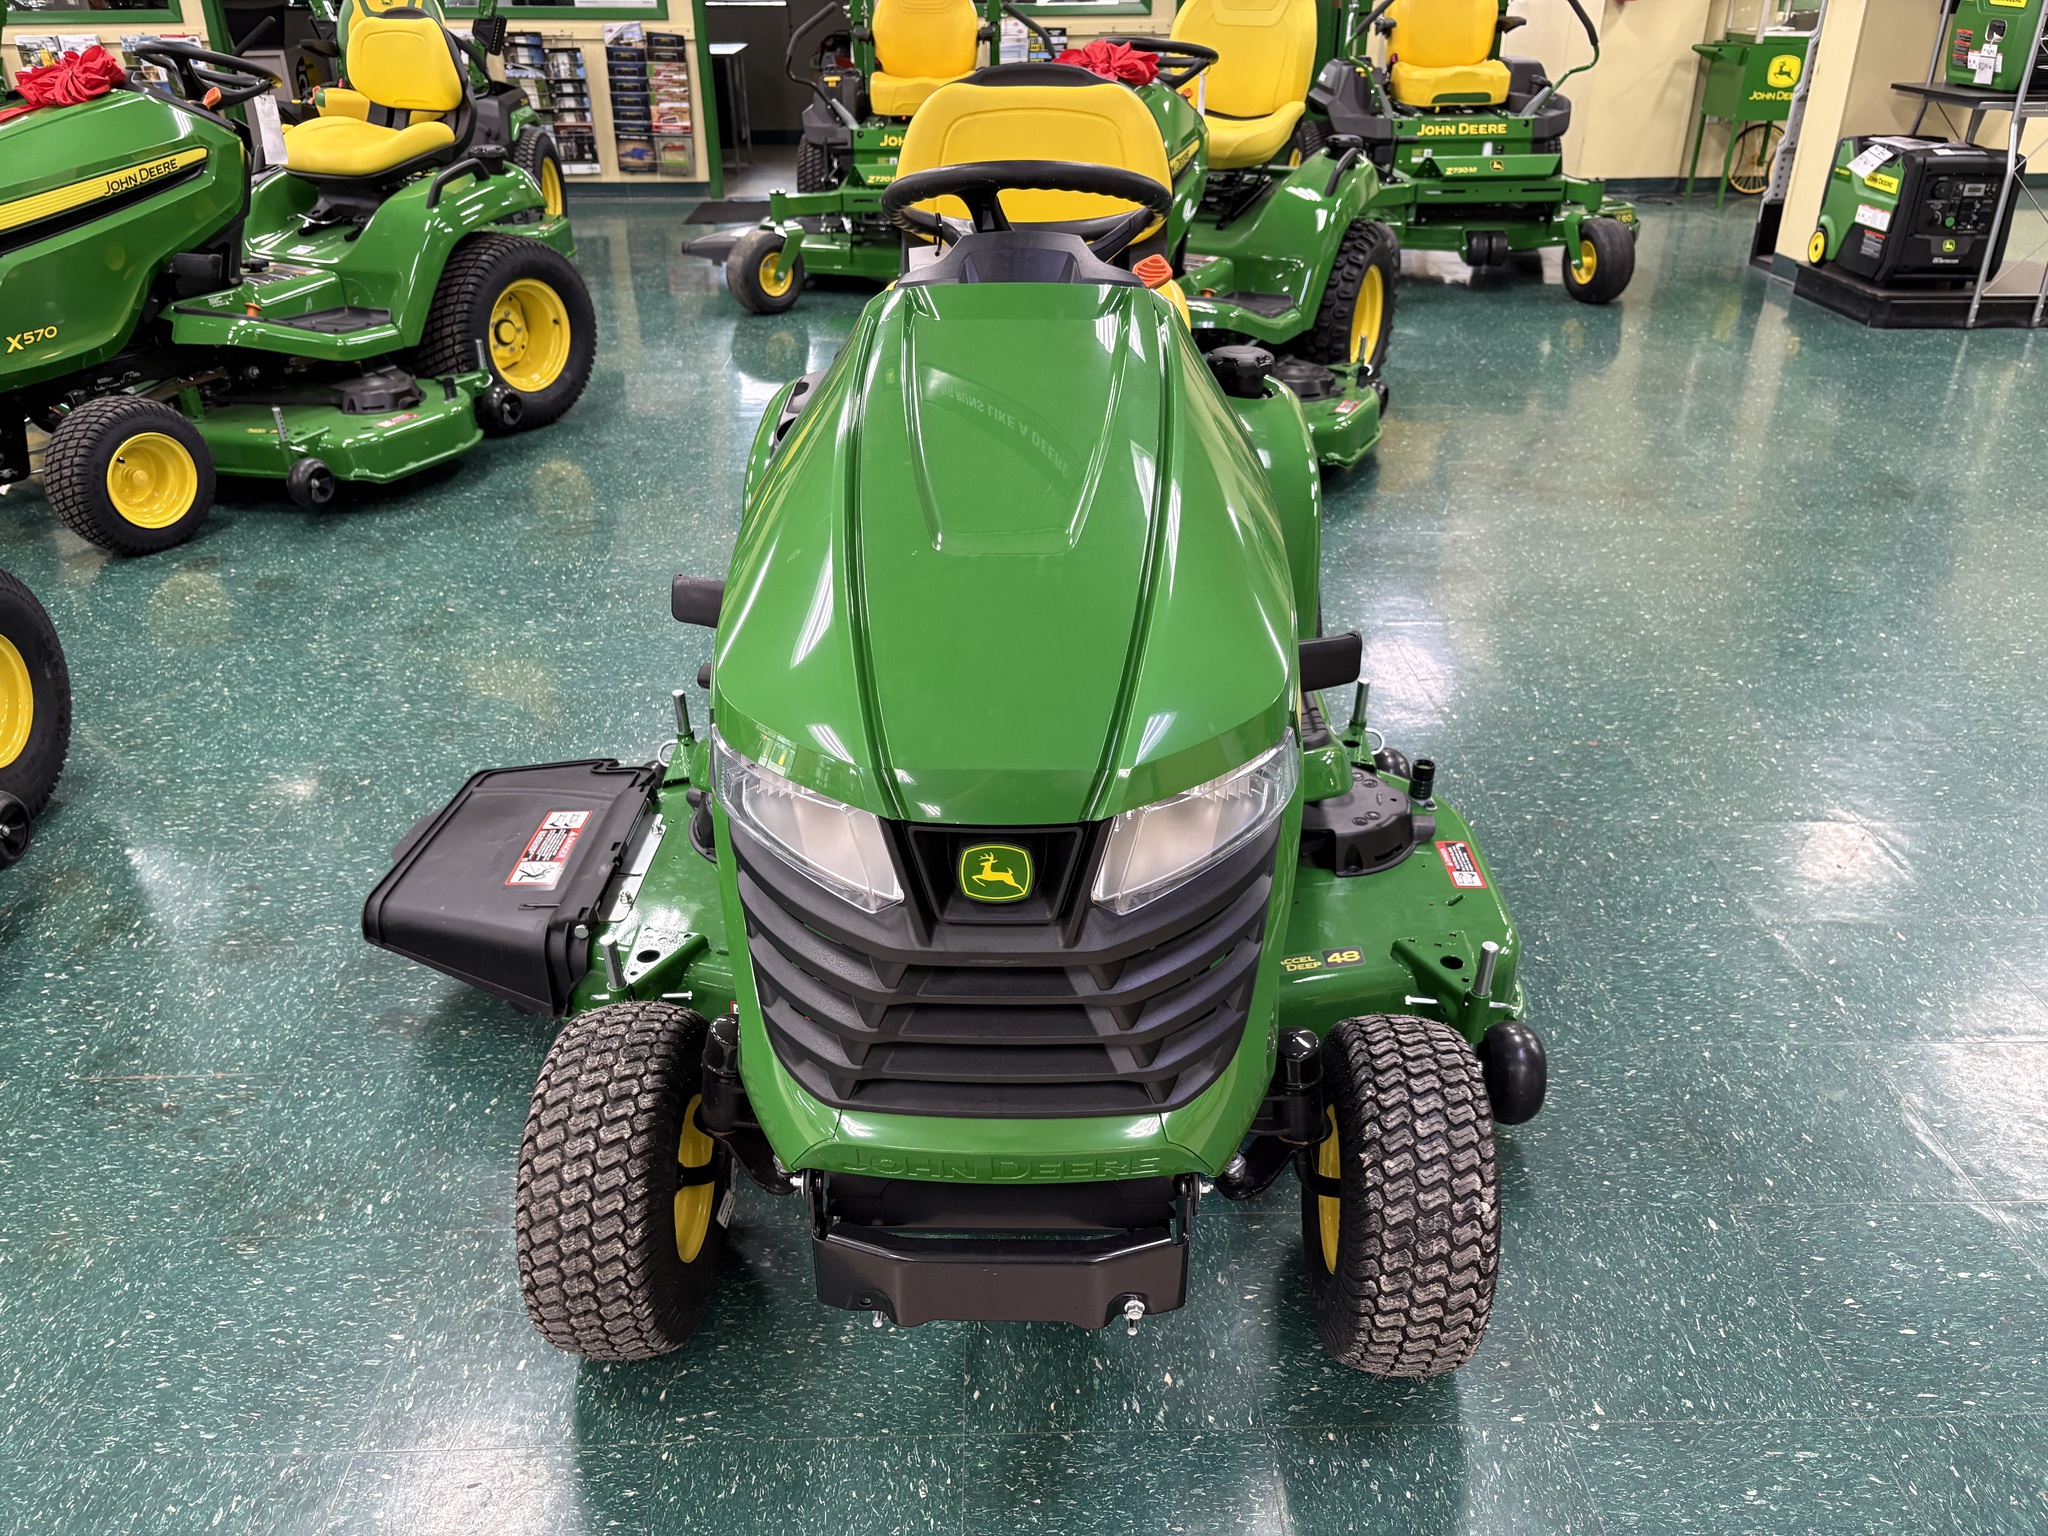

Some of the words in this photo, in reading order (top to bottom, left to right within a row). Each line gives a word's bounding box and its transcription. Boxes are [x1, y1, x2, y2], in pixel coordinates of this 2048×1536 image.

[1748, 90, 1776, 101] JOHN
[1776, 90, 1794, 101] DEE
[1417, 124, 1456, 136] JOHN
[1458, 123, 1508, 135] DEERE
[880, 134, 905, 147] JOH
[104, 172, 138, 195] JOHN
[139, 159, 178, 183] DEERE
[5, 326, 58, 353] X570
[1327, 950, 1361, 964] 48
[1286, 961, 1322, 972] DEEP
[843, 1149, 977, 1180] JOHN
[992, 1156, 1160, 1181] DEERE
